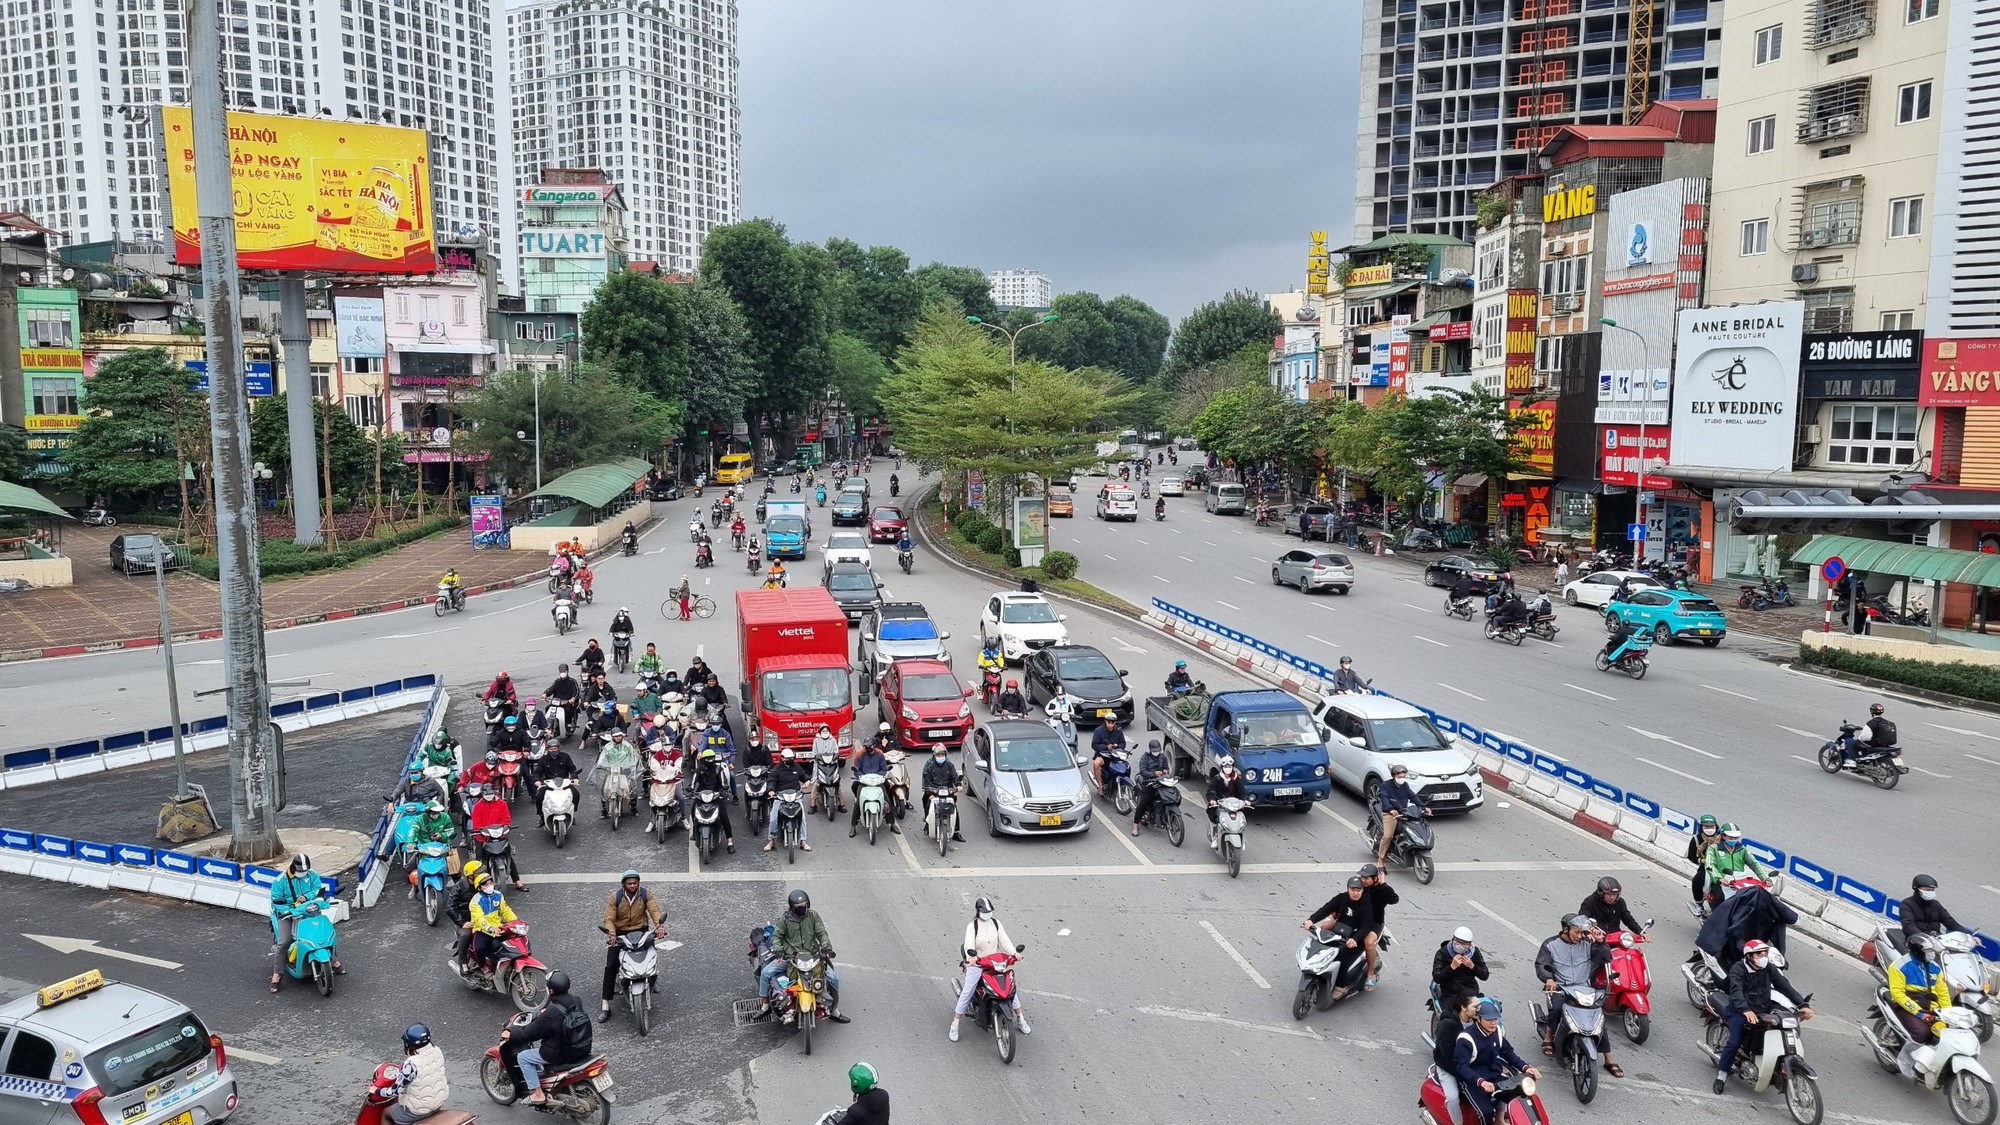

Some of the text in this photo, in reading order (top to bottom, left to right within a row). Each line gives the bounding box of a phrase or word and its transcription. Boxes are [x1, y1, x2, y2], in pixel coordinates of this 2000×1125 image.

[229, 125, 278, 146] HÀ NỘI
[257, 155, 300, 169] NGAY
[273, 169, 302, 180] VÀNG
[333, 169, 348, 178] BIA
[376, 180, 392, 191] BIA
[359, 187, 400, 211] HÀ NỘI
[525, 188, 597, 204] Kangaroo
[1543, 183, 1595, 223] VÀNG
[255, 221, 281, 230] VÀNG
[523, 232, 603, 254] TUART
[1359, 271, 1374, 284] ĐẠI
[1508, 291, 1536, 318] VÀNG
[1692, 317, 1784, 333] ANNE BRIDAL
[1506, 322, 1535, 353] NHẪN
[1392, 345, 1407, 356] THAY
[1809, 334, 1912, 360] 26 ĐƯỜNG LÁNG
[1931, 365, 1990, 392] VÀNG
[1860, 379, 1896, 395] NAM
[1600, 408, 1611, 420] MÁY
[1651, 411, 1664, 423] ĐẠT
[1691, 401, 1783, 415] ELY WEDDING
[29, 419, 37, 428] 11
[1605, 452, 1623, 472] MÁY
[778, 627, 815, 636] viettel
[1263, 768, 1282, 782] 24H
[66, 979, 100, 995] THANH NGA
[74, 977, 87, 985] TAXI
[67, 1064, 81, 1076] 347
